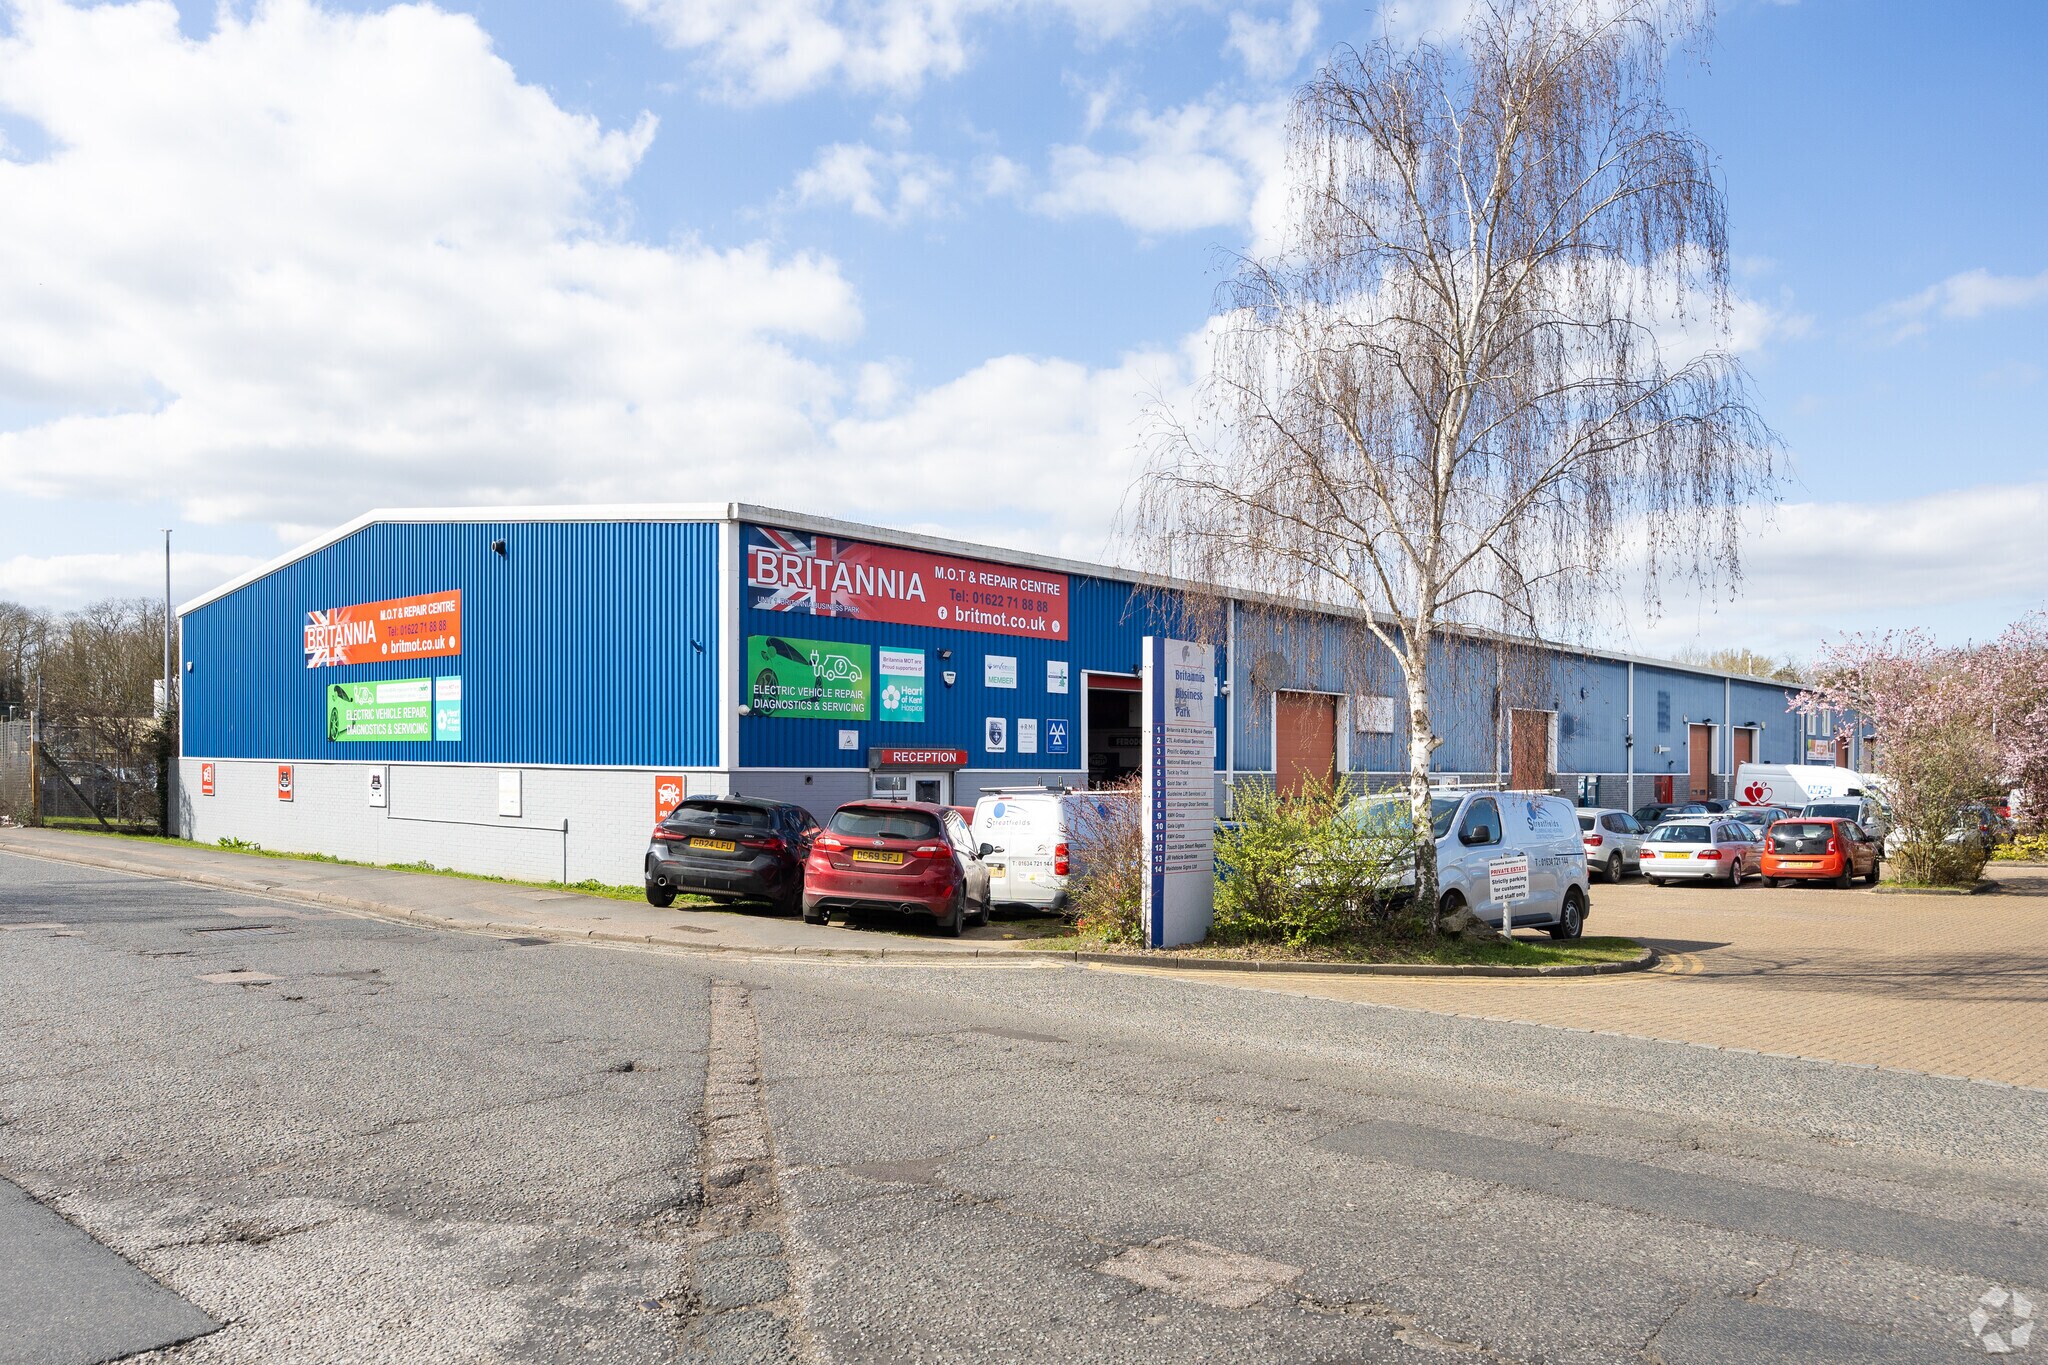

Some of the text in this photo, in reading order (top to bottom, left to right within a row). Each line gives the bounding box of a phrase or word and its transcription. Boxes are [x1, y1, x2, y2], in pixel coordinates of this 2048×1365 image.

[756, 549, 926, 603] BRITANNIA
[935, 566, 1060, 596] M.O.T & REPAIR CENTRE
[949, 588, 1048, 613] Tel: 01622 71 88 88
[398, 607, 404, 618] &
[404, 603, 427, 618] REPAIR
[427, 600, 456, 614] CENTRE
[844, 605, 860, 613] PARK
[955, 606, 1046, 631] britmot.co.uk
[400, 624, 419, 636] 01622
[420, 623, 427, 633] 71
[429, 621, 437, 632] 88
[438, 620, 447, 631] 88
[306, 620, 377, 651] BRITANNIA
[390, 635, 446, 654] britmot.co.uk
[988, 676, 1014, 684] MEMBER
[1175, 669, 1205, 683] Britannia
[753, 684, 796, 696] ELECTRIC
[797, 687, 833, 698] VEHICLE
[901, 685, 923, 696] Heart
[1175, 687, 1204, 701] Business
[901, 696, 923, 704] of Kent
[753, 699, 865, 713] DIAGNOSTICS & SERVICING
[901, 704, 923, 713] Hospice
[346, 708, 375, 721] ELECTRIC
[376, 707, 402, 720] VEHICLE
[1175, 706, 1191, 718] Park
[346, 722, 428, 736] DIAGNOSTICS & SERVICING
[1156, 726, 1161, 734] 1
[1156, 736, 1161, 744] 2
[893, 751, 957, 762] RECEPTION
[1156, 747, 1161, 755] 3
[1156, 779, 1162, 787] 6
[1807, 785, 1832, 796] NHS
[1157, 812, 1162, 820] 9
[986, 817, 1031, 829] Streatfields
[1155, 822, 1163, 830] 10
[1155, 833, 1163, 841] 11
[715, 841, 733, 850] LFU
[1155, 844, 1163, 852] 12
[881, 852, 899, 863] SFJ
[1154, 865, 1162, 873] 14
[1490, 865, 1527, 875] PRIVATE ESTATE
[1509, 876, 1527, 884] parking
[1501, 884, 1526, 892] customers
